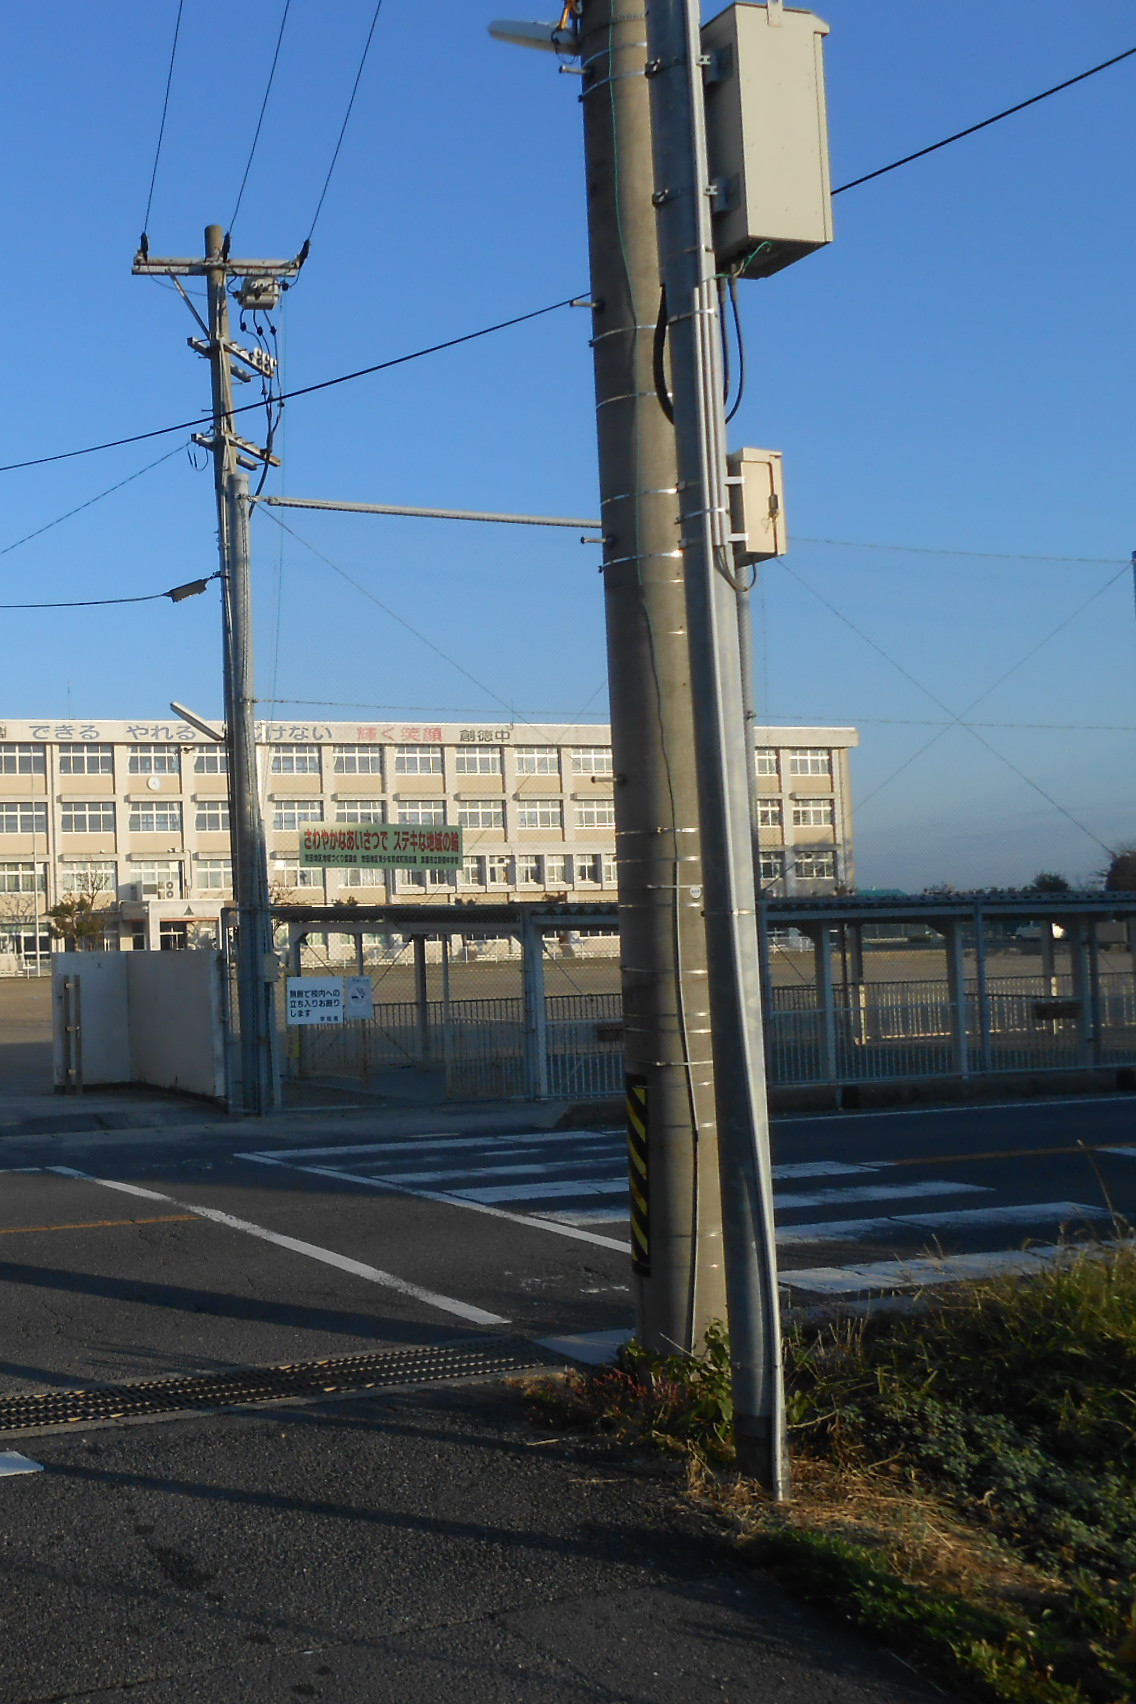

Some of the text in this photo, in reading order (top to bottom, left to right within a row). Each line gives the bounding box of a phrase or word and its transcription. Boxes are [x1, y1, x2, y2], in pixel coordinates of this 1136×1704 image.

[29, 724, 100, 741] できる
[126, 725, 196, 741] やれる
[356, 727, 443, 742] 輝く笑顔
[459, 729, 511, 742] 創徳中
[304, 829, 388, 851] さわやかなあいさつで
[289, 999, 340, 1008] 立ち入りお断り
[290, 1009, 311, 1018] します
